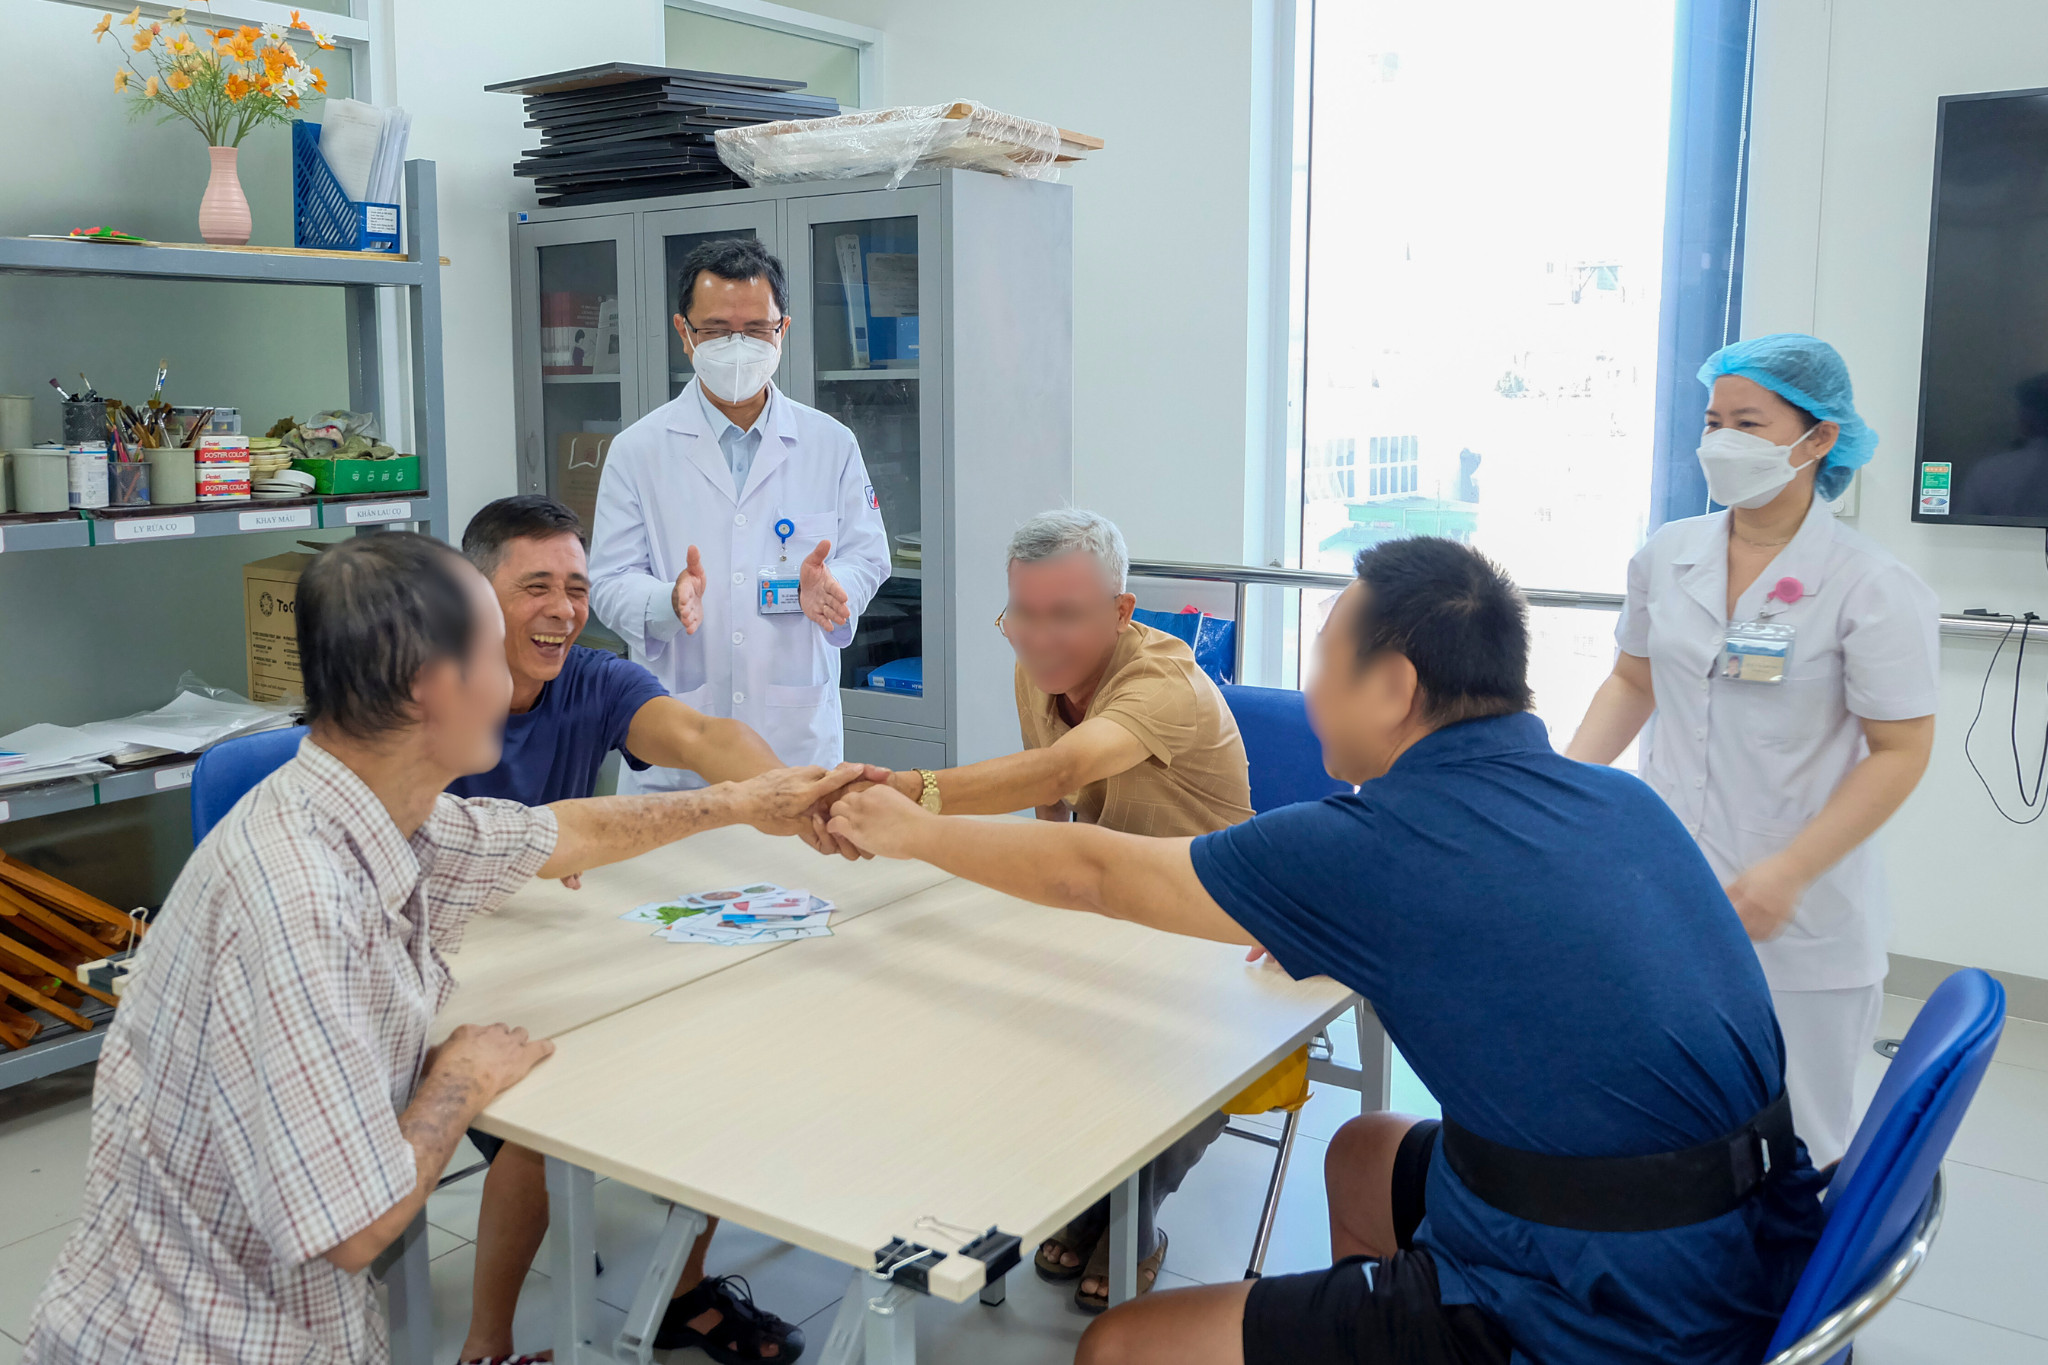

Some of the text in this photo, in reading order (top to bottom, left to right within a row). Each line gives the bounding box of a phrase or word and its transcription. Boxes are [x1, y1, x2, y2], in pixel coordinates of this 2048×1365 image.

[377, 508, 390, 516] LAU
[255, 516, 276, 525] KHAY
[133, 525, 144, 534] LY
[276, 598, 295, 614] ToC
